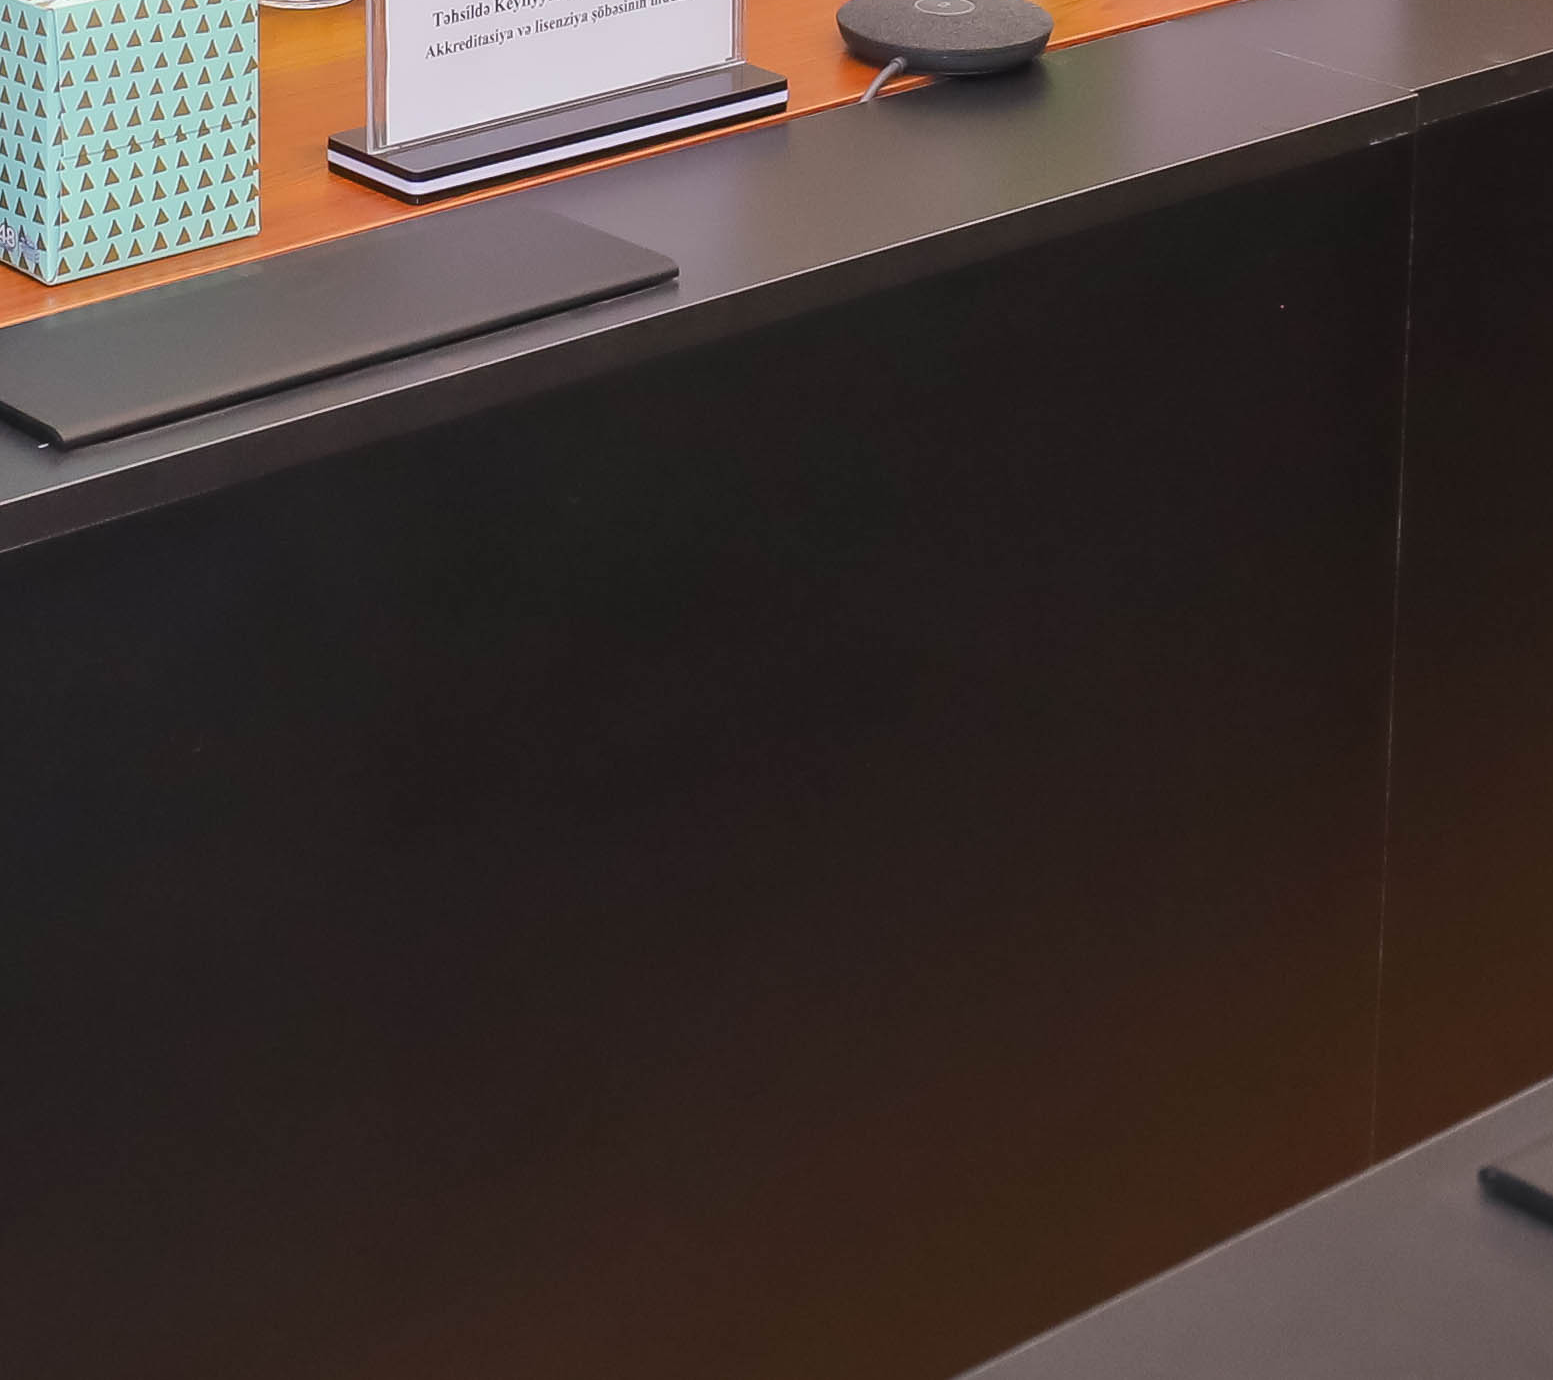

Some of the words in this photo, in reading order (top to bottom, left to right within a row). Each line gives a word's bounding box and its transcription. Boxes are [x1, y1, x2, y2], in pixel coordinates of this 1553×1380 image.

[432, 2, 491, 27] Təhsildə
[425, 28, 514, 59] Akkreditasiya
[516, 25, 532, 37] və
[534, 11, 588, 34] lisenziya
